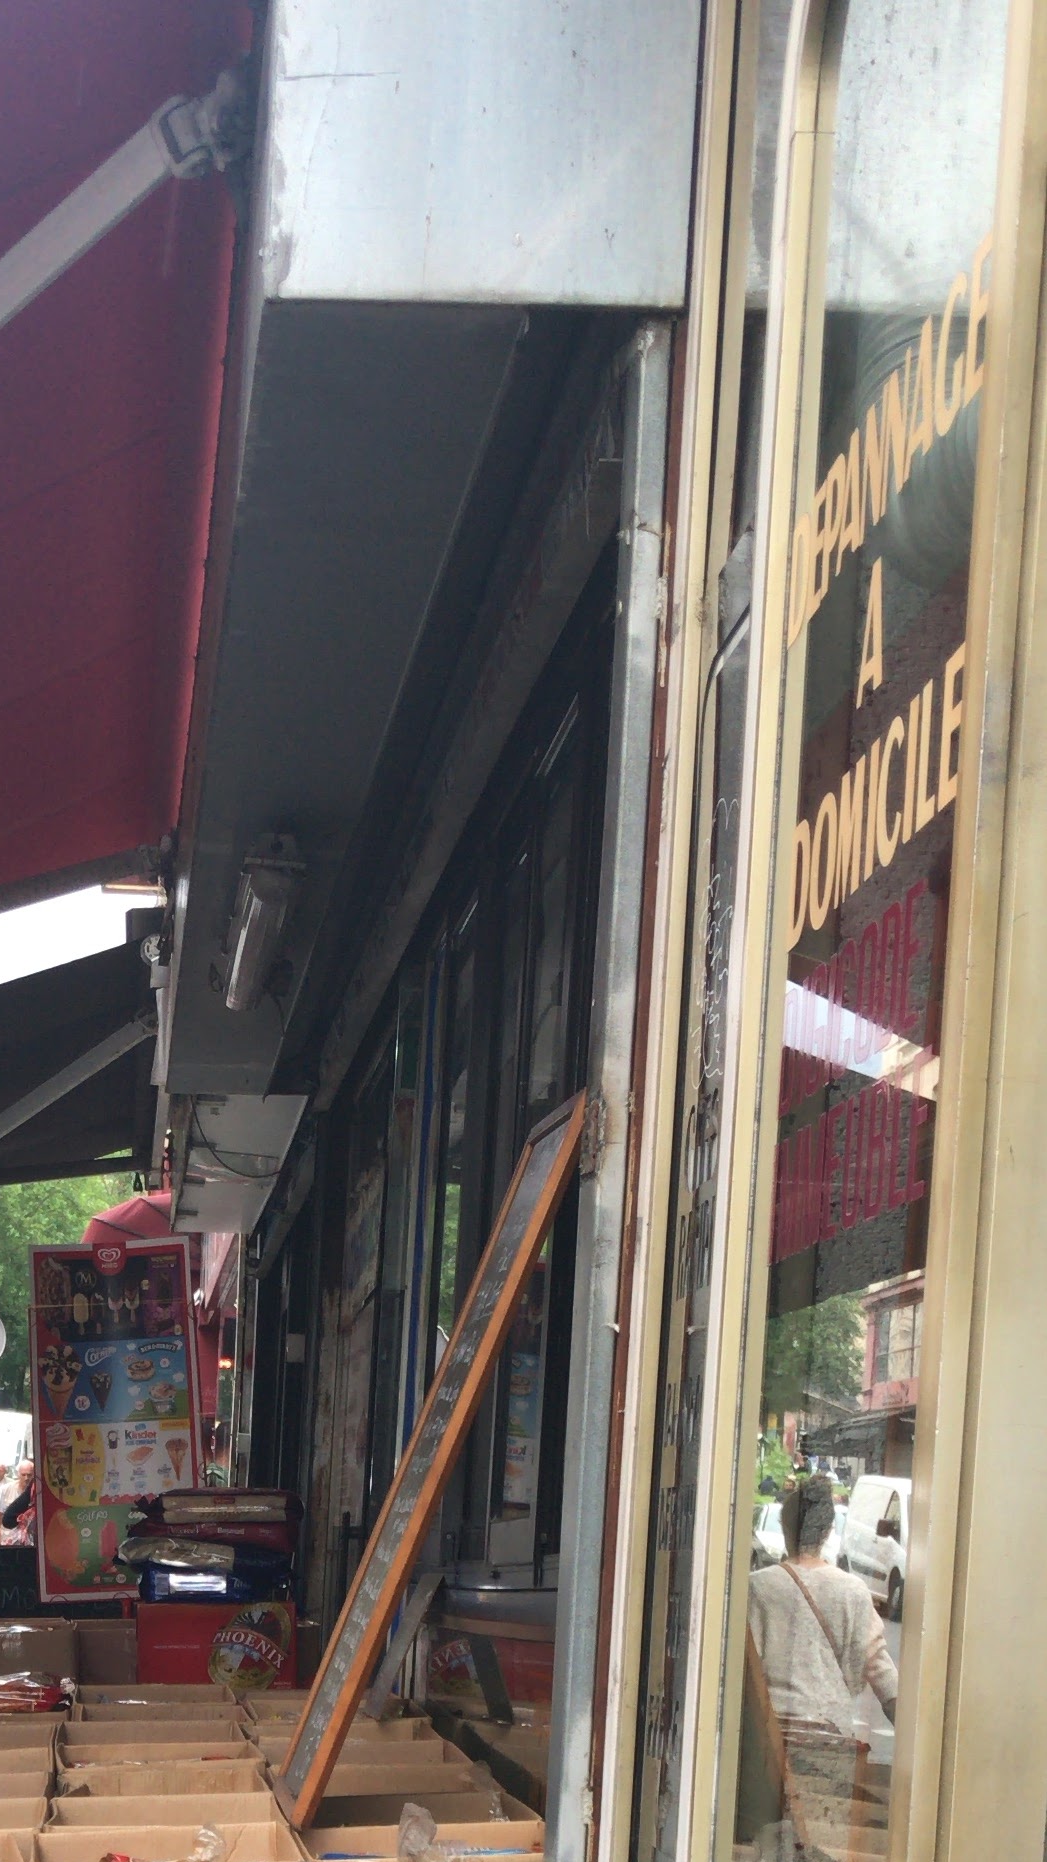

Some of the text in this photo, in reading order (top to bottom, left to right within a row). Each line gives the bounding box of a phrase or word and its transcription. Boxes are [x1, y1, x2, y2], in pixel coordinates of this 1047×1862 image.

[786, 232, 994, 648] DEPANNAGE
[855, 556, 883, 710] A
[786, 641, 966, 953] DOMICILE
[212, 1631, 287, 1669] PHOENIX
